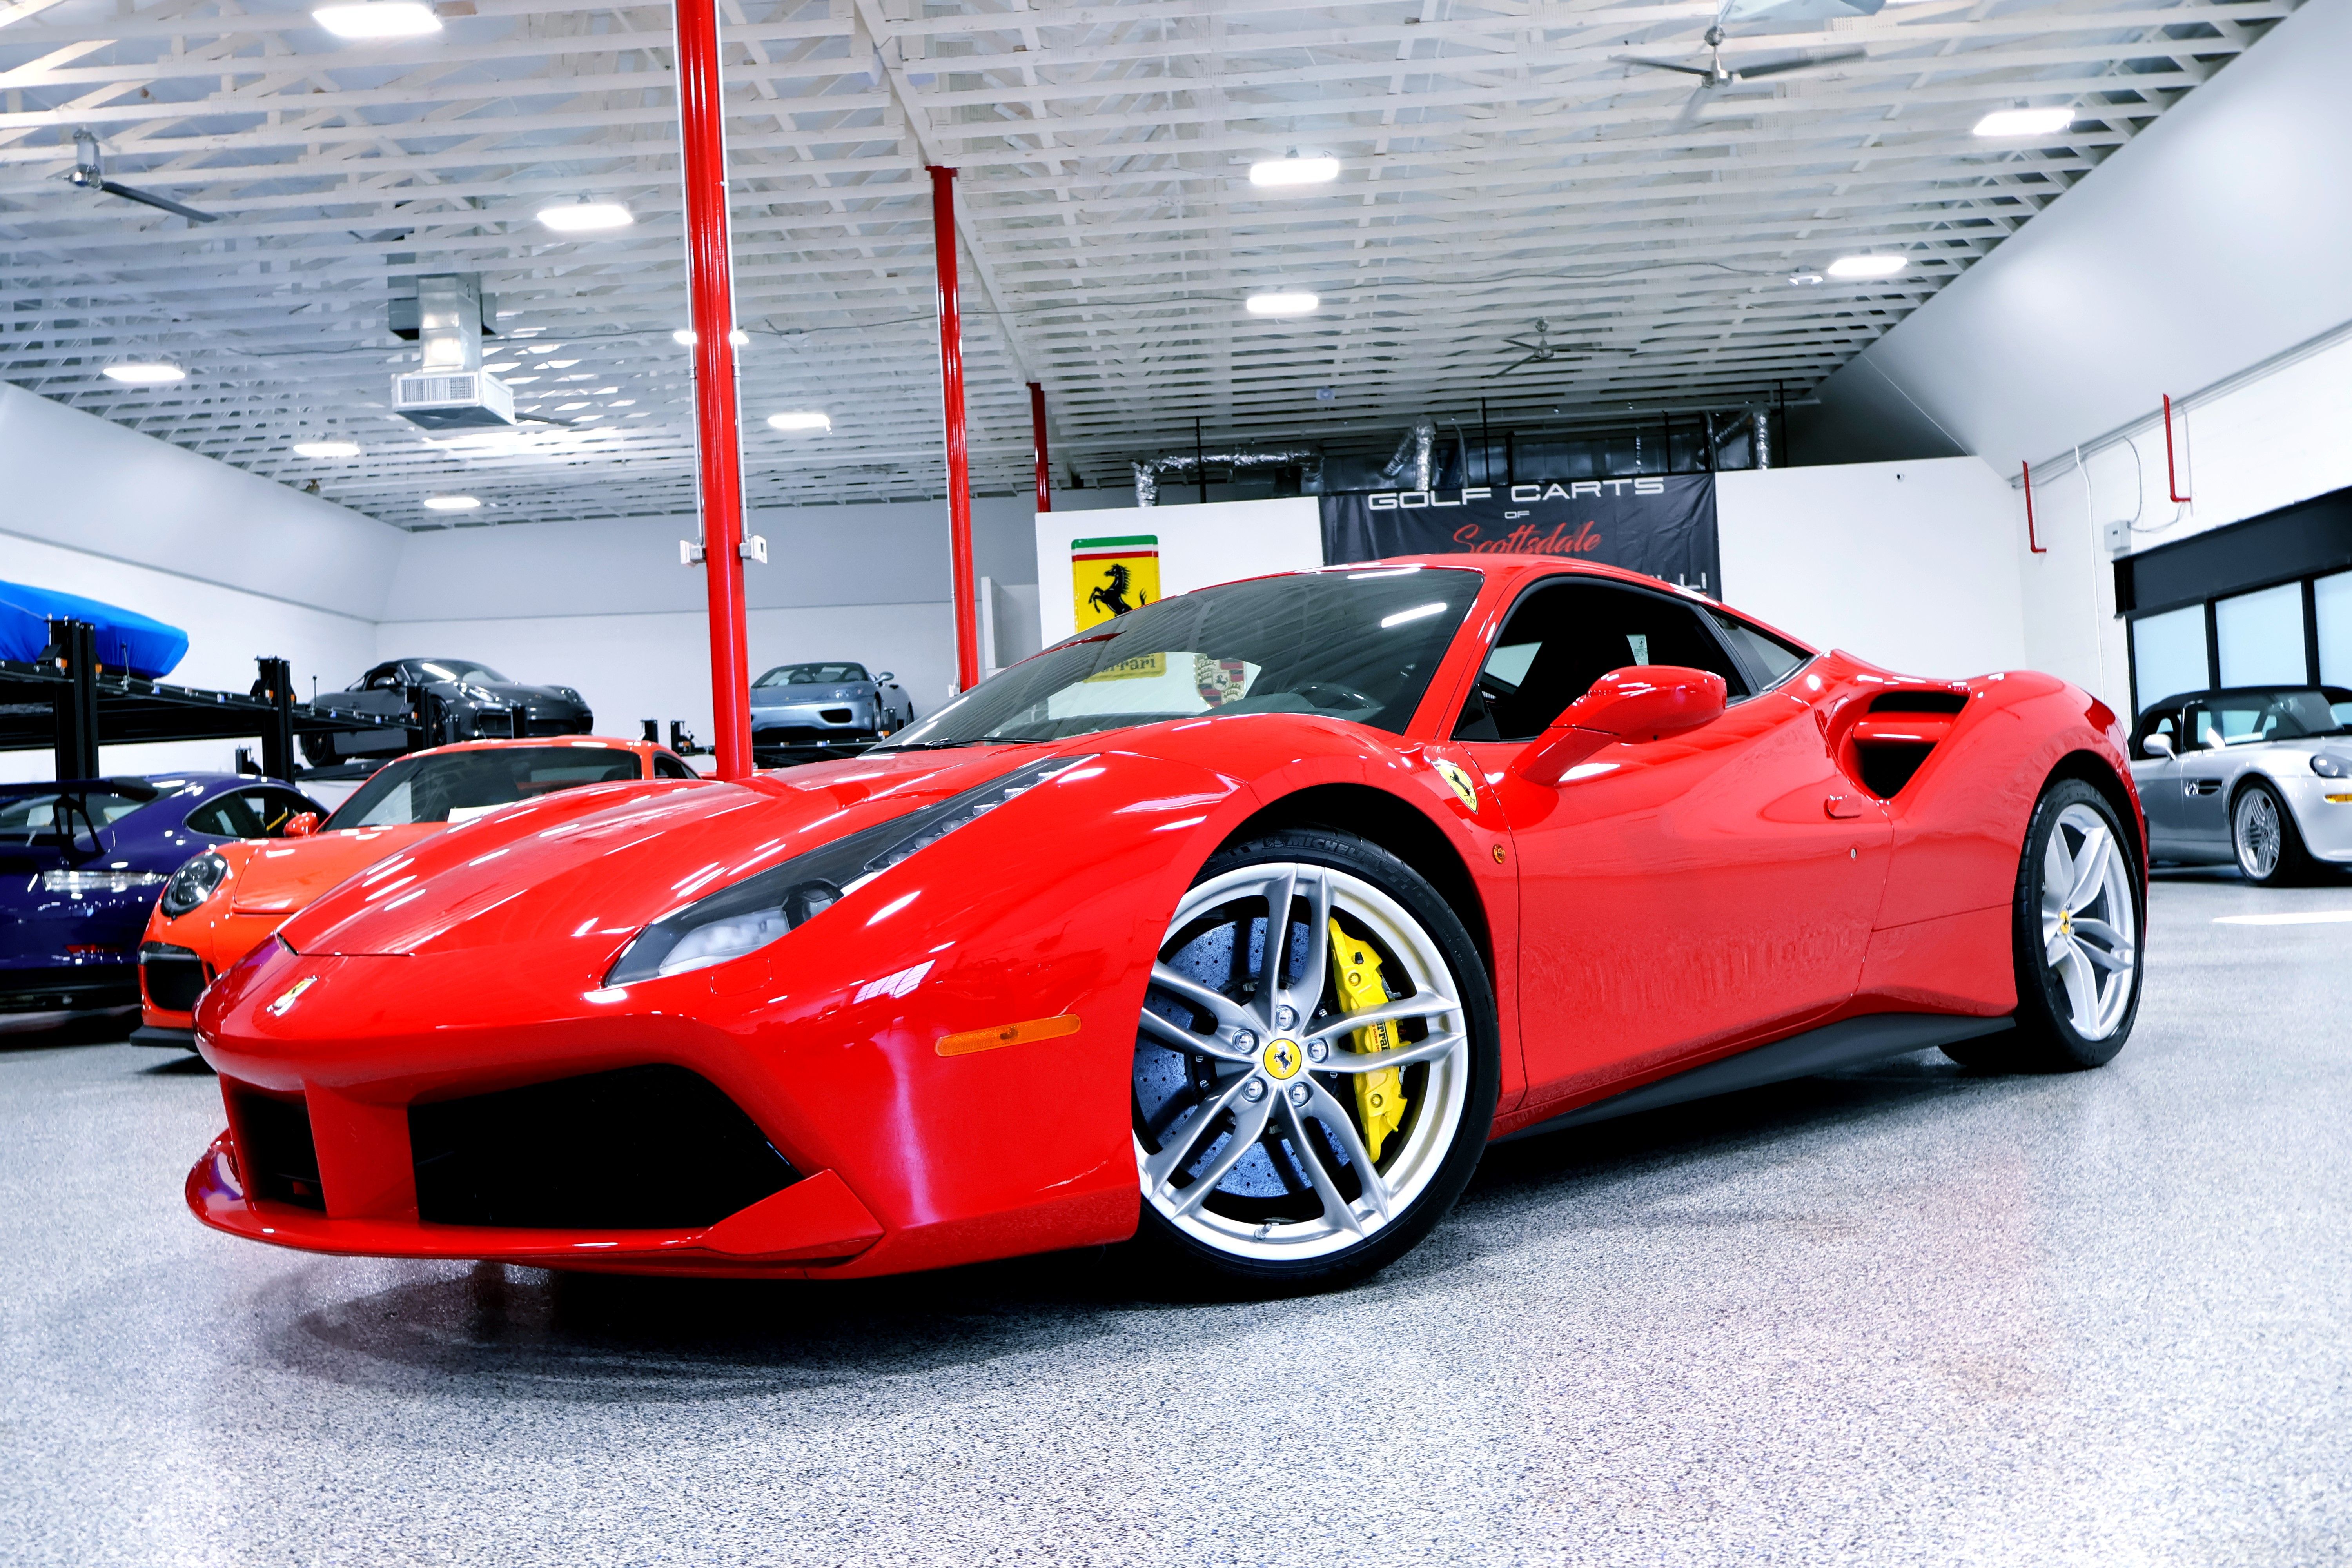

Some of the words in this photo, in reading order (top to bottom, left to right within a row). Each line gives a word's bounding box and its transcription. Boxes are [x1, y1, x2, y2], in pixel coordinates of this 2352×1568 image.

[1368, 487, 1492, 510] GOLF
[1510, 477, 1664, 502] CARTS
[1504, 510, 1530, 519] OF
[1450, 520, 1602, 555] Scottsdale
